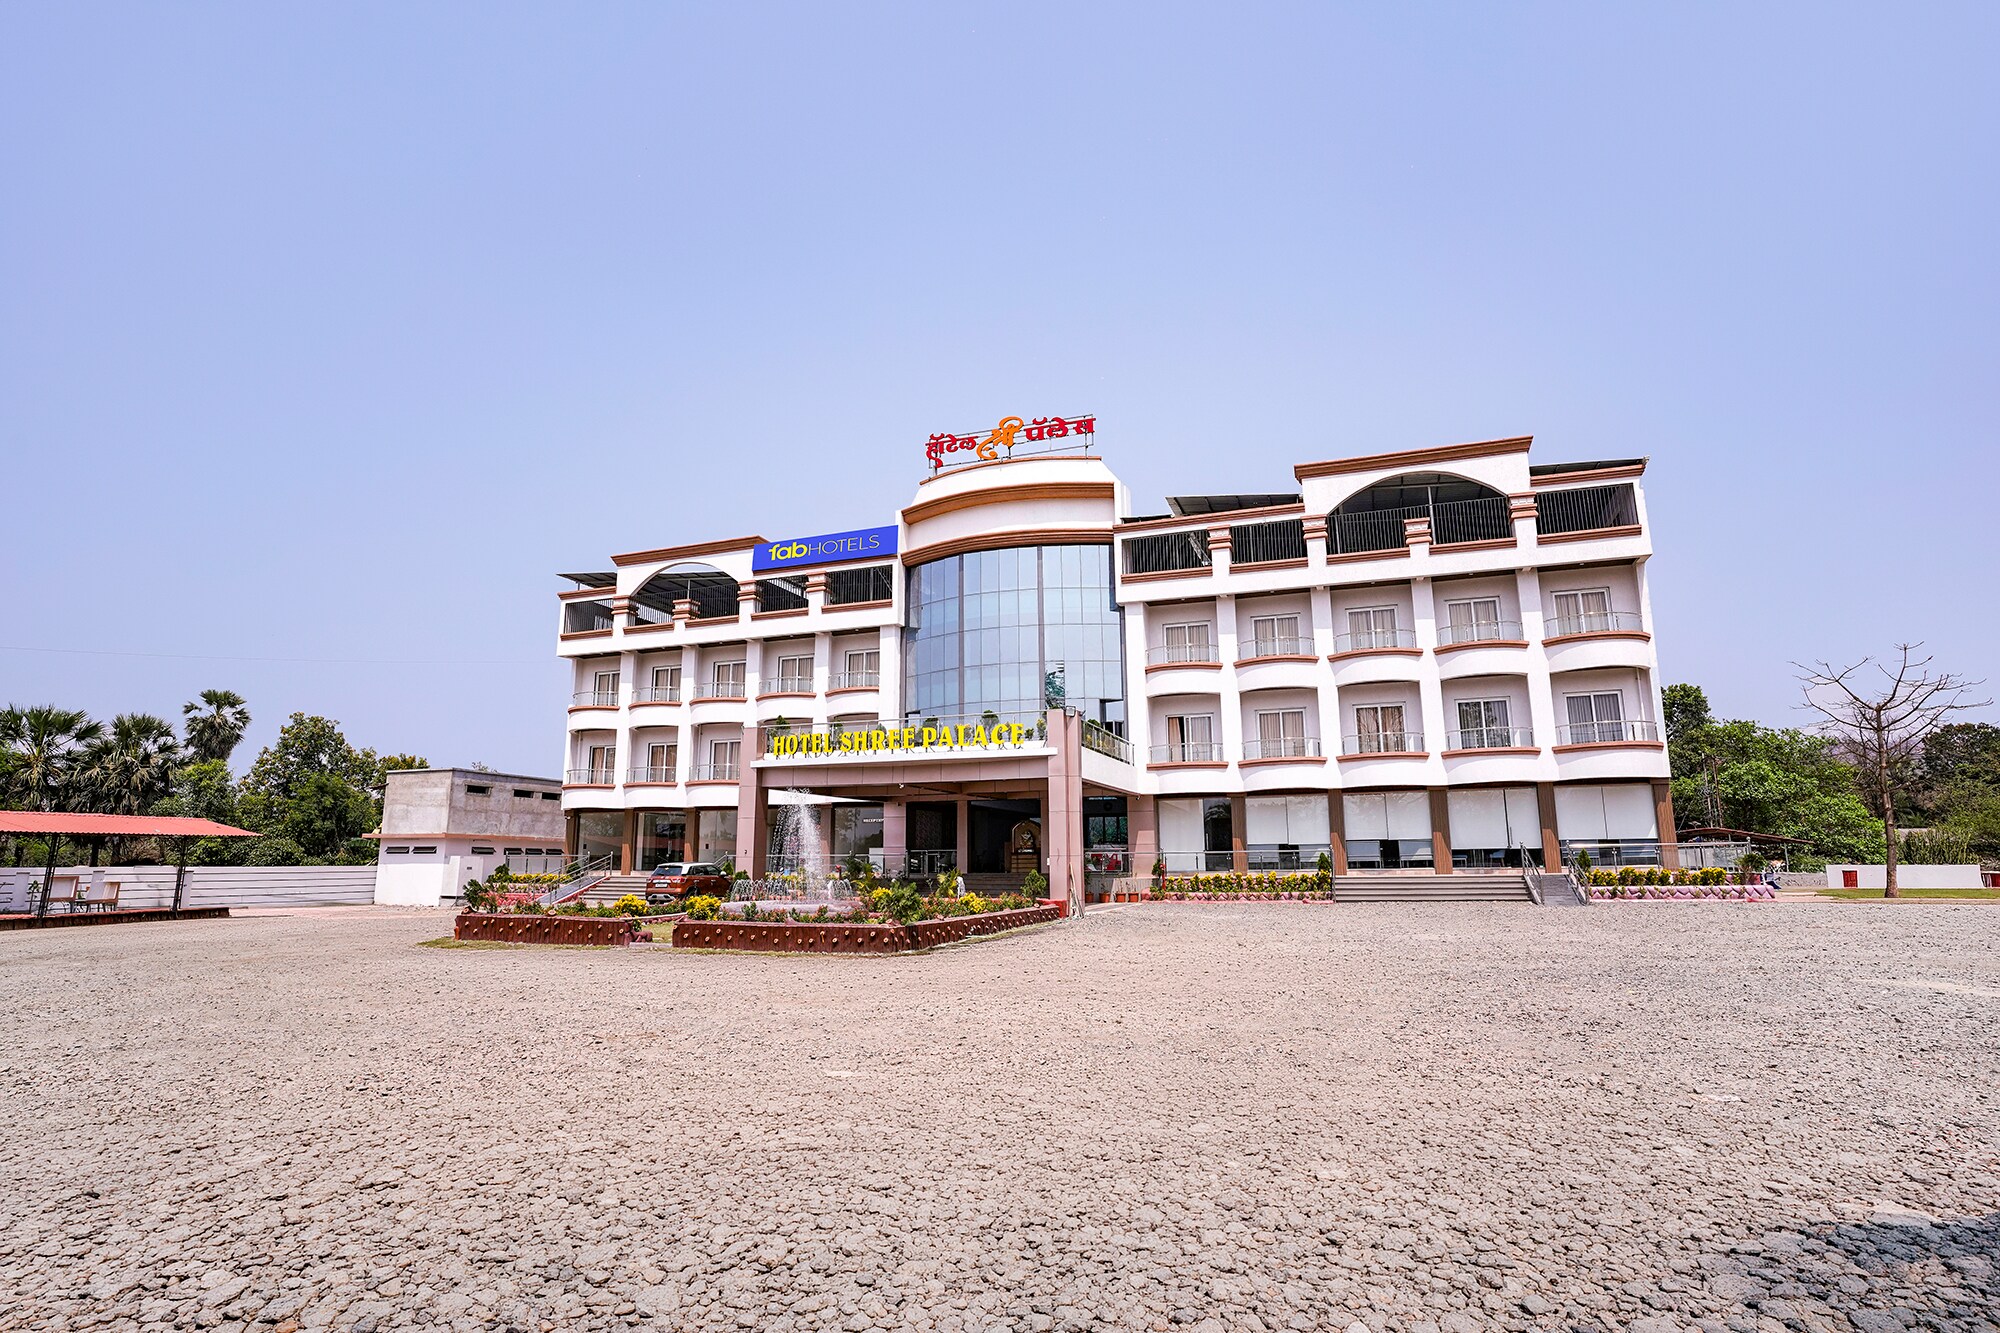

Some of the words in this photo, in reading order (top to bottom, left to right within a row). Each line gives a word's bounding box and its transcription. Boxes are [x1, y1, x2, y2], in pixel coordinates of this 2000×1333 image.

[926, 433, 978, 468] हॉटेल
[976, 416, 1024, 460] श्री
[773, 734, 833, 756] HOTEL
[839, 728, 915, 752] SHREE
[922, 723, 1024, 748] PALACE
